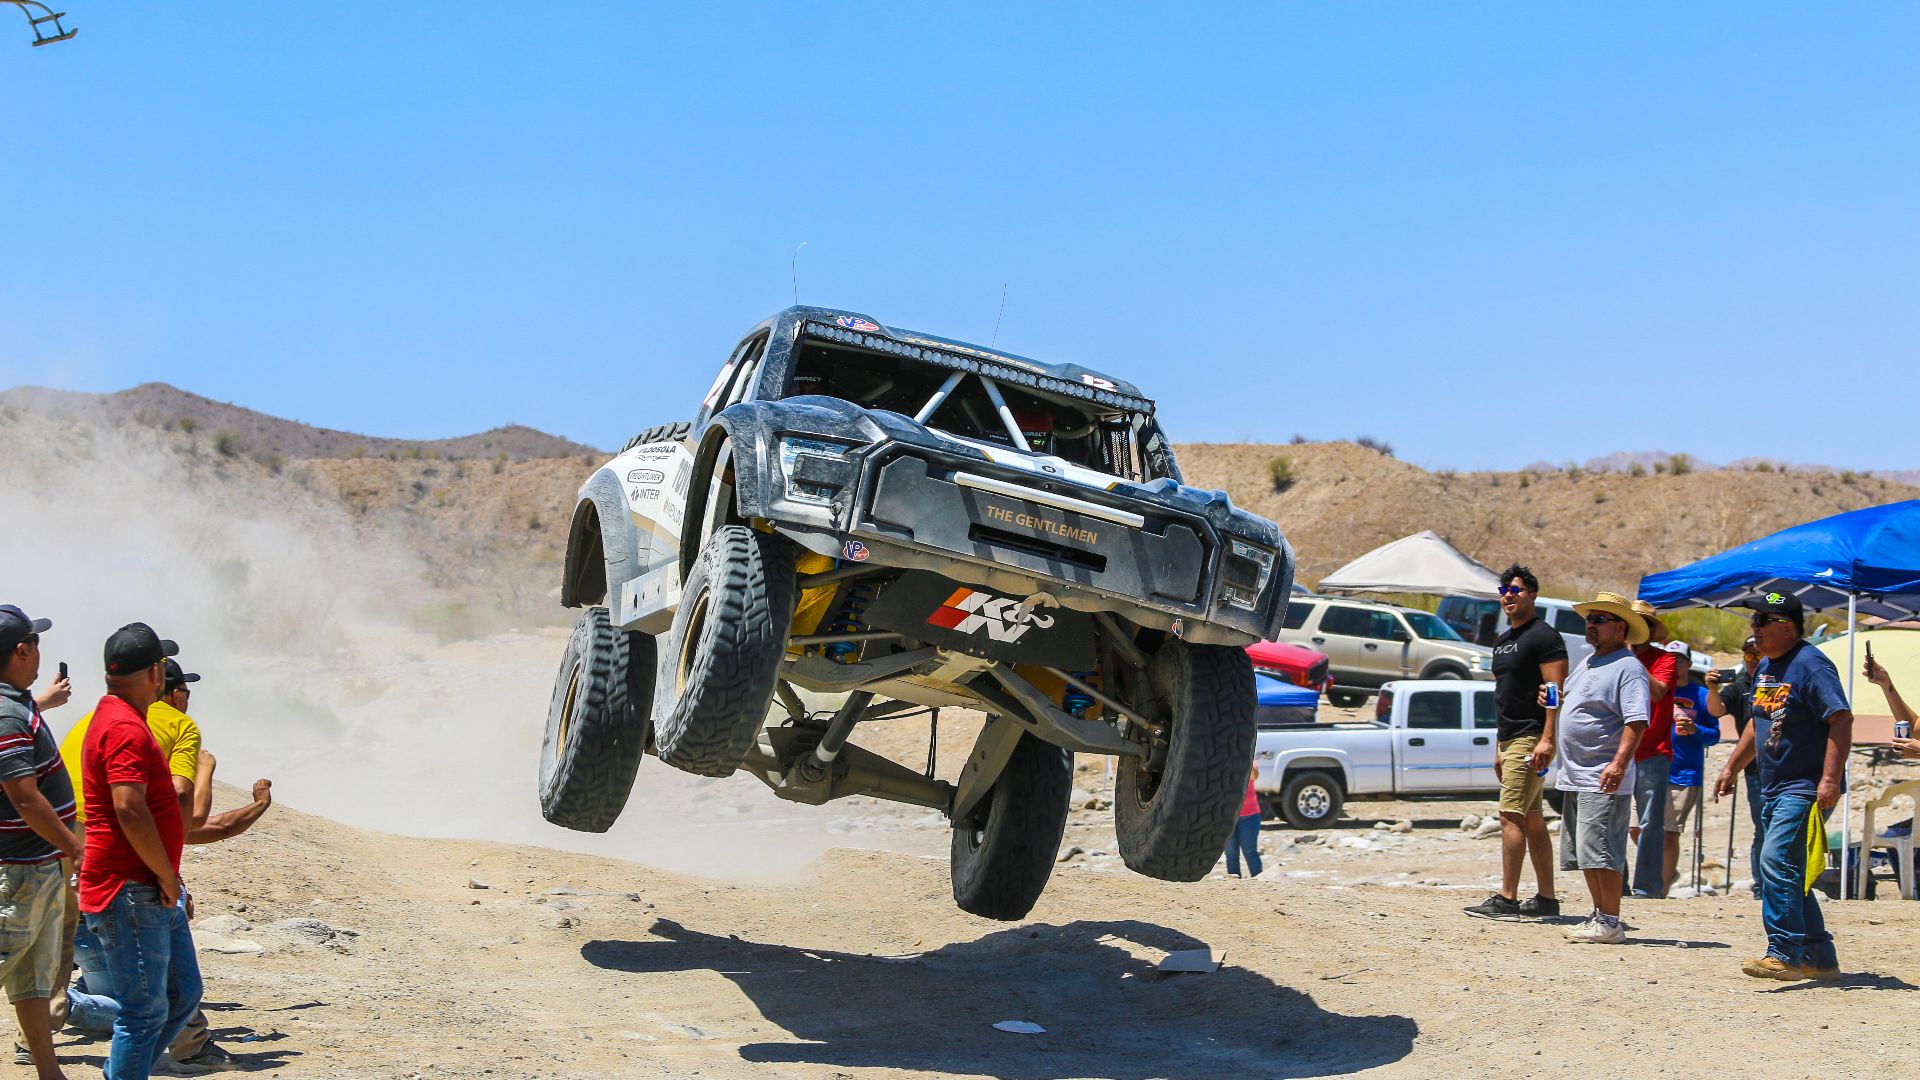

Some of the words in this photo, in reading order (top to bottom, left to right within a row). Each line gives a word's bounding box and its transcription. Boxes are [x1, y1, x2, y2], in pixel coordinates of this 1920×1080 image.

[987, 505, 1015, 523] THE
[1015, 513, 1098, 545] GENTLEMEN
[845, 540, 864, 559] VP
